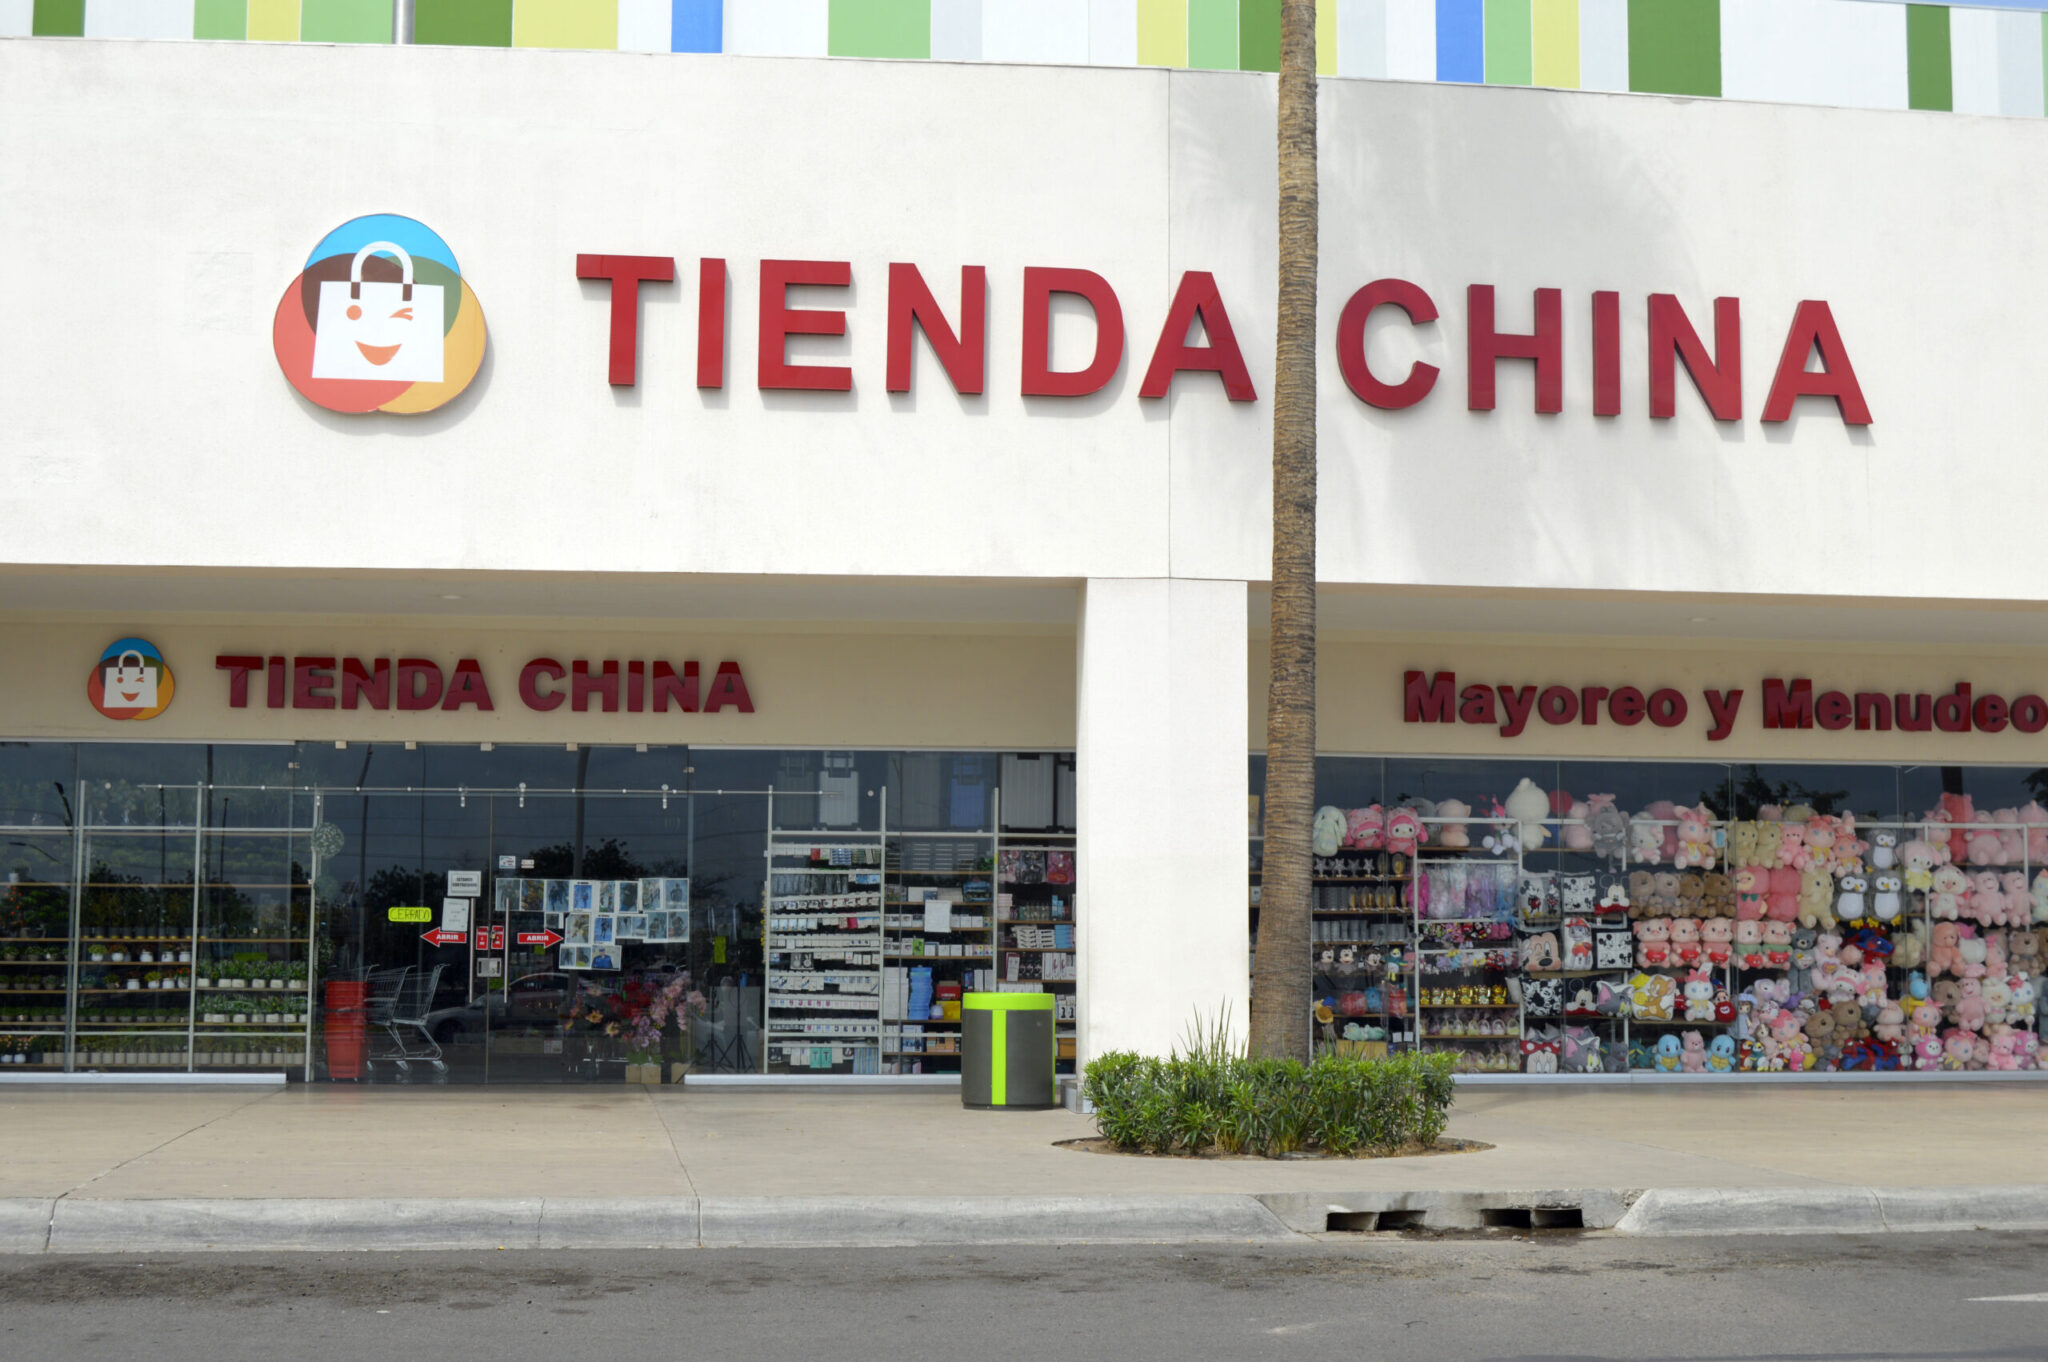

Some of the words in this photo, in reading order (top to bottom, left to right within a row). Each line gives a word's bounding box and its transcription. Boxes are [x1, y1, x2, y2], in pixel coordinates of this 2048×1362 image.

[576, 254, 1258, 402] TIENDA
[1335, 277, 1873, 426] CHINA
[216, 655, 493, 711] TIENDA
[519, 657, 754, 713] CHINA
[1404, 671, 1687, 736] Mayoreo
[1704, 689, 1744, 739] y
[1764, 679, 2048, 733] Menudeo
